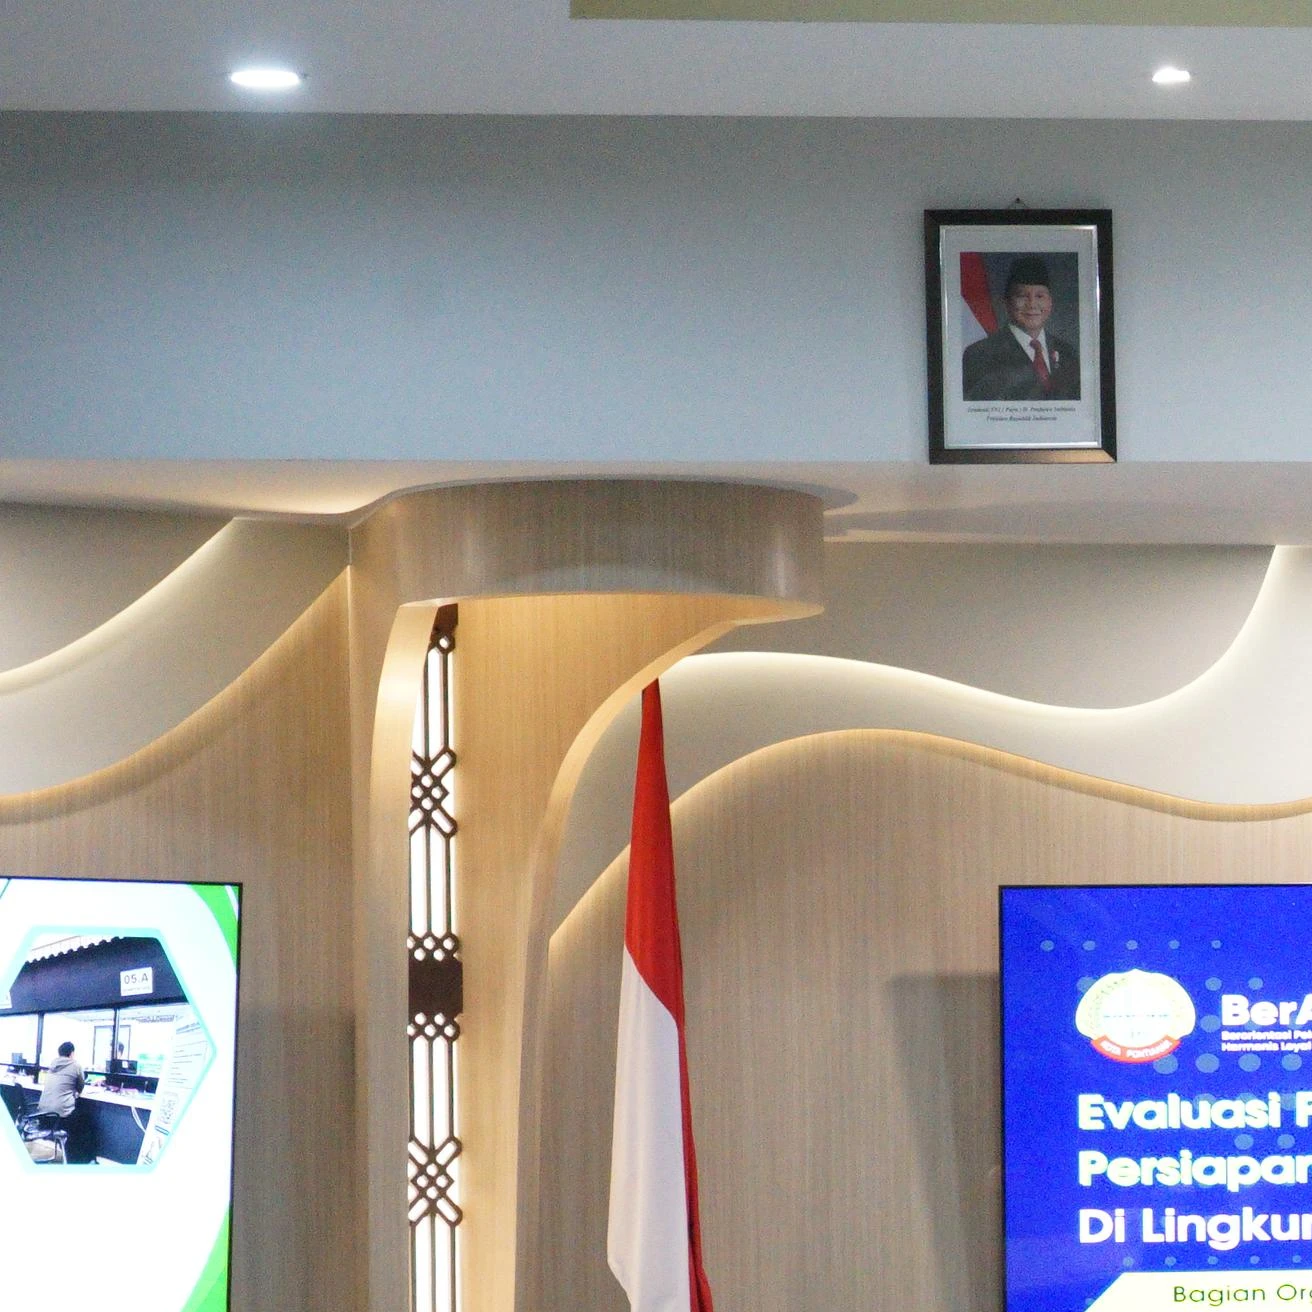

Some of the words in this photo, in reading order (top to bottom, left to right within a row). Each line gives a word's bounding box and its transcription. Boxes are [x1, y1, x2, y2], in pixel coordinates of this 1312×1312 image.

[1078, 1092, 1282, 1131] Evaluasi
[1078, 1207, 1126, 1244] Di
[1174, 1285, 1266, 1307] Bagian
